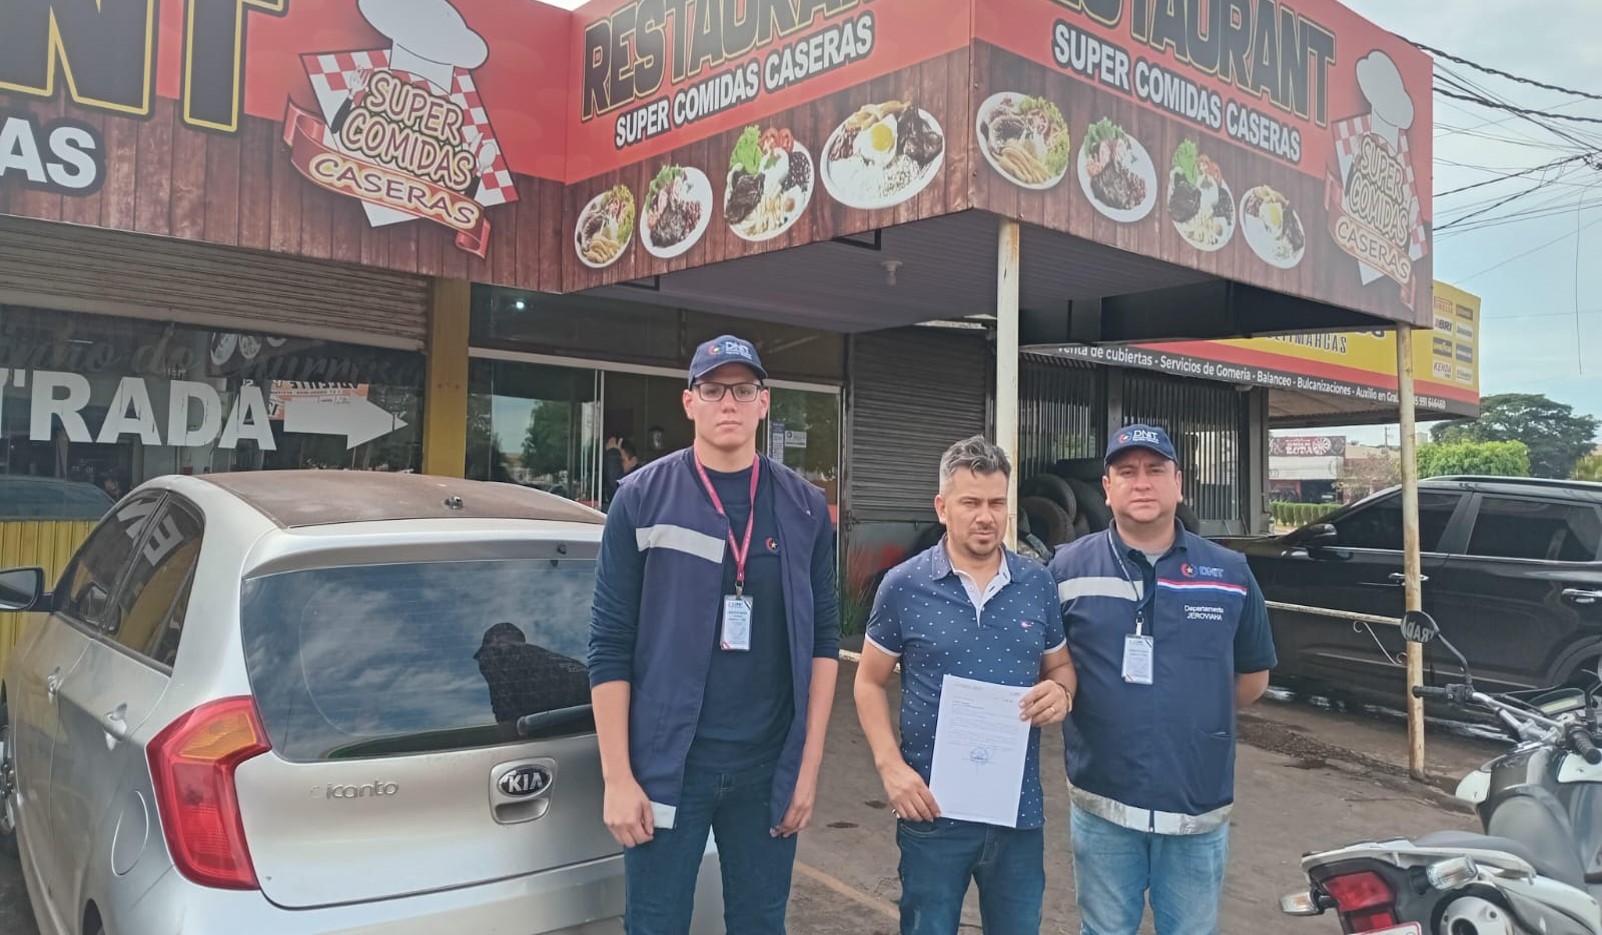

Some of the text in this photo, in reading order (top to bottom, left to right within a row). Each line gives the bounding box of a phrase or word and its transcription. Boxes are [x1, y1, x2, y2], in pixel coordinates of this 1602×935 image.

[368, 71, 463, 144] SUPER
[614, 14, 873, 148] SUPER COMIDAS CASERAS
[1054, 23, 1300, 163] SUPER COMIDAS CASERAS
[0, 116, 97, 189] AS
[340, 108, 476, 193] COMIDAS
[1361, 135, 1404, 204] SUPER
[310, 153, 480, 230] CASERAS
[1350, 172, 1409, 246] COMIDAS
[1335, 216, 1412, 283] CASERAS
[1105, 346, 1153, 366] cubiertas
[1160, 355, 1201, 374] Servicios
[1202, 361, 1215, 376] de
[1216, 364, 1250, 380] Gomeria
[1257, 370, 1292, 387] Balanceo
[1297, 377, 1352, 396] Bulcanizaciones
[508, 771, 543, 793] KIA
